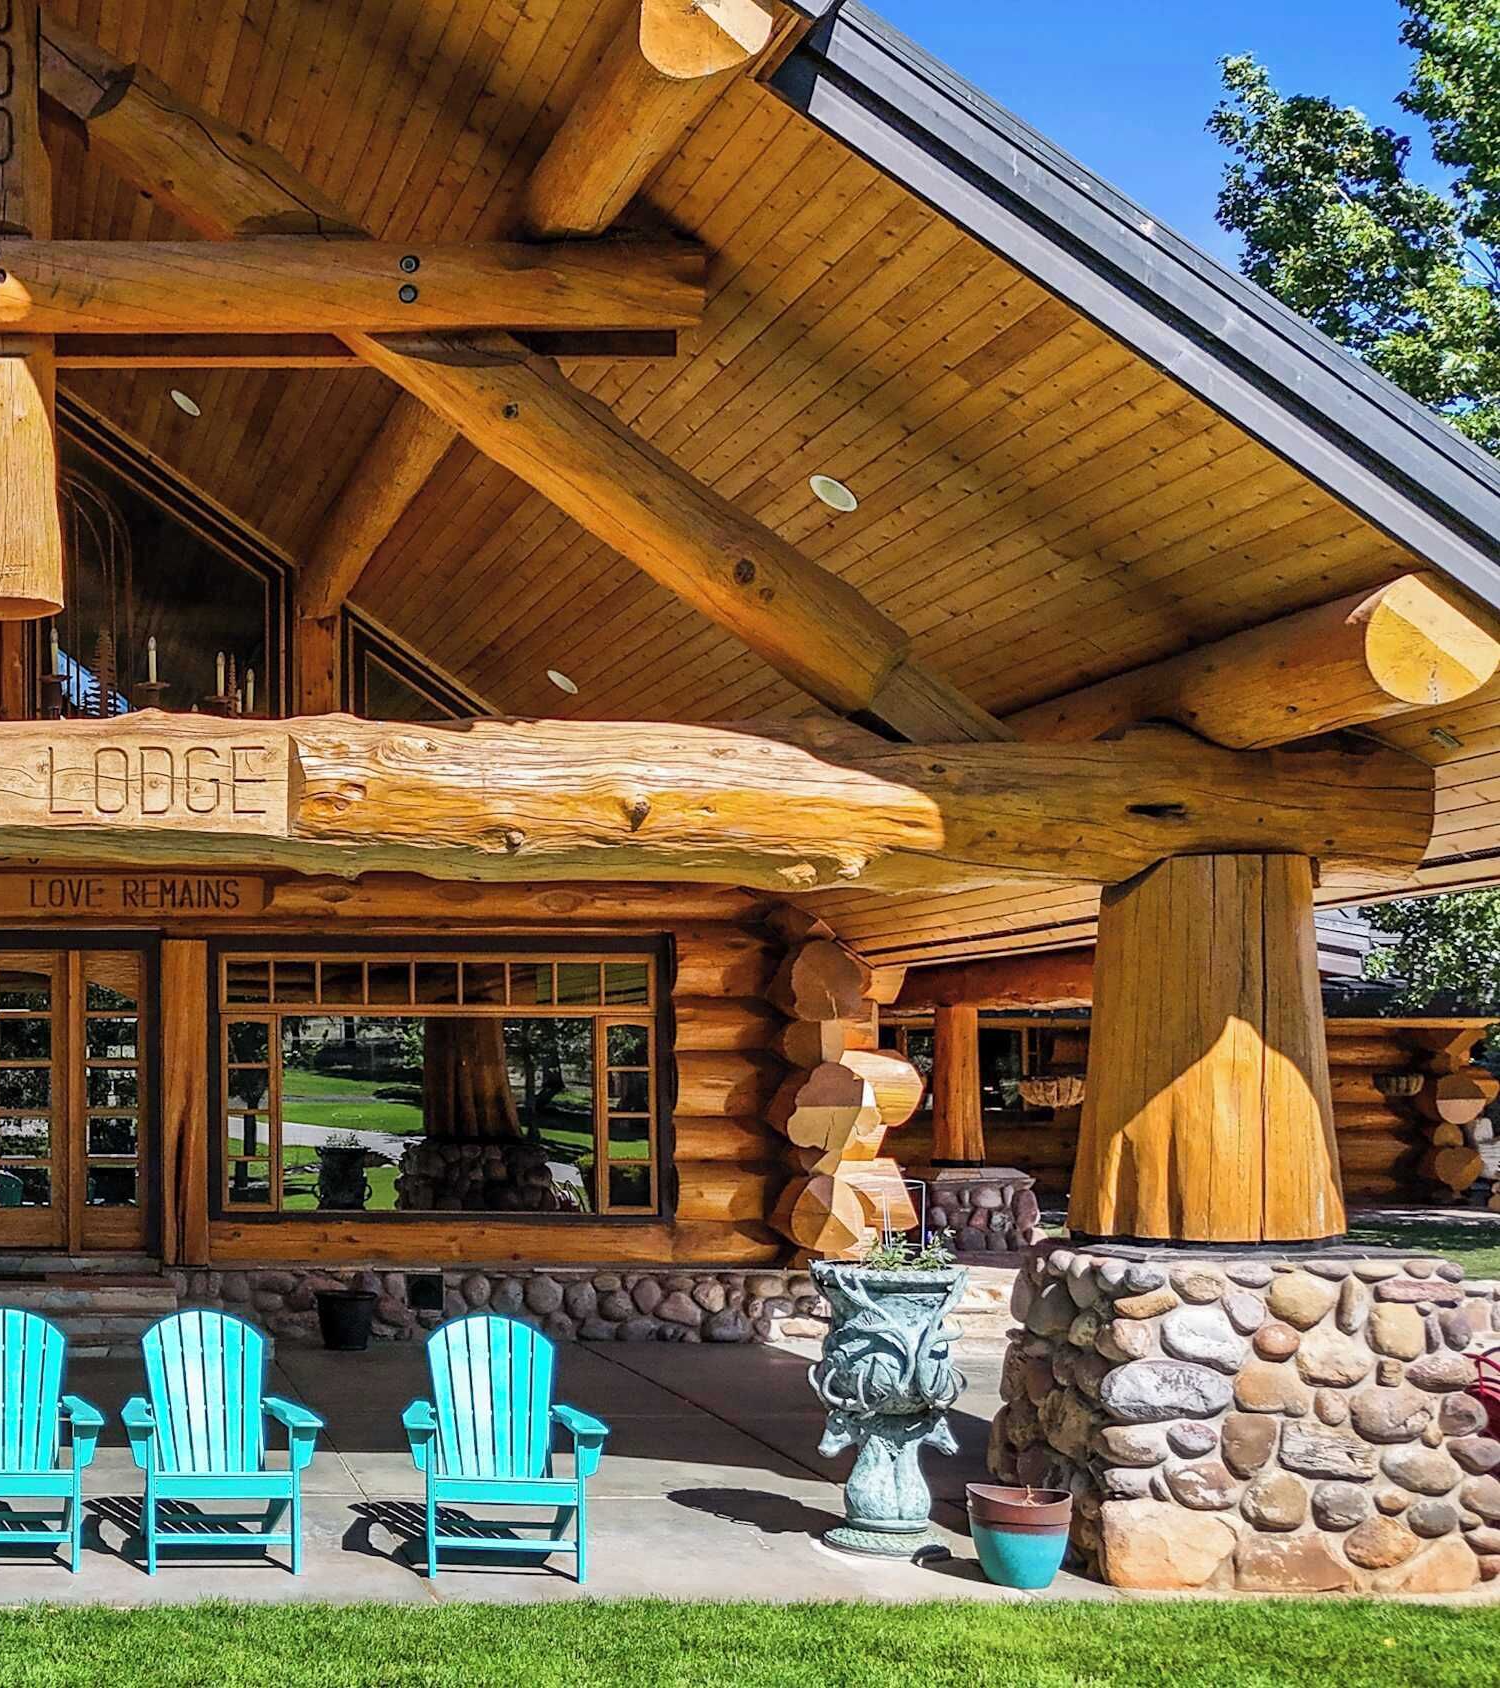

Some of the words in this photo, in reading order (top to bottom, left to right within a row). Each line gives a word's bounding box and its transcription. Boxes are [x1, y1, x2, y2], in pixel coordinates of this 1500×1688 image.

[48, 746, 267, 814] LODGE
[30, 879, 104, 909] LOVE
[122, 879, 240, 910] REMAINS
